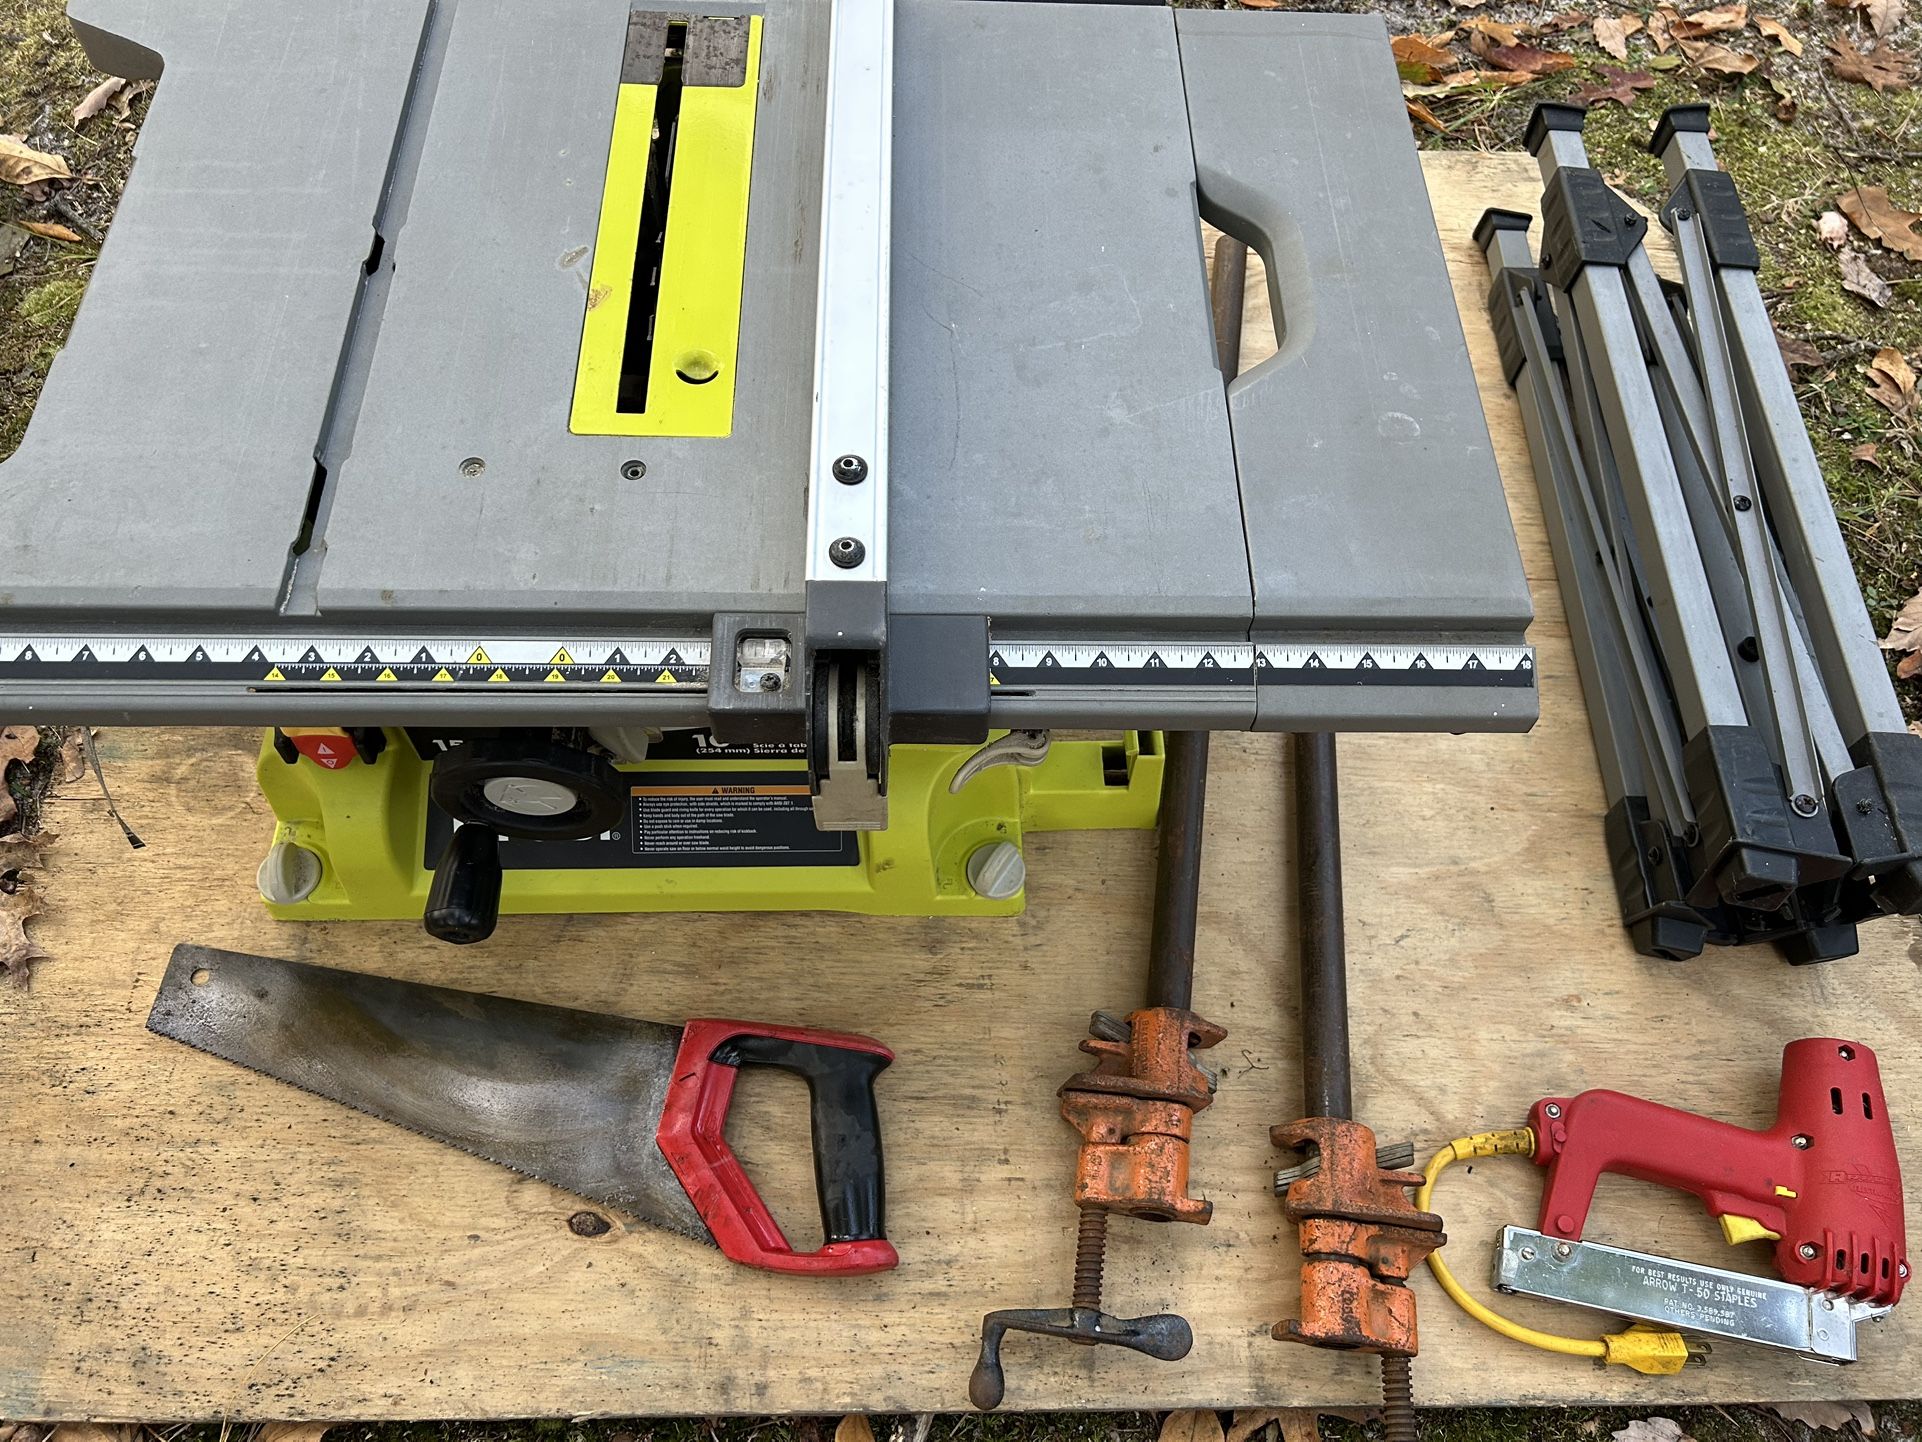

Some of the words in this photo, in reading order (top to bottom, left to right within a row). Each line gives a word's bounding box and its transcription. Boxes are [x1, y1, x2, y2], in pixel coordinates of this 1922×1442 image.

[24, 650, 32, 661] 8
[82, 651, 89, 660] 7
[138, 651, 146, 661] 6
[195, 651, 203, 661] 5
[252, 651, 260, 661] 4
[308, 652, 316, 662] 3
[364, 652, 372, 662] 2
[420, 652, 426, 662] 1
[476, 653, 482, 661] 0
[559, 654, 565, 662] 0
[614, 654, 621, 662] 1
[669, 654, 677, 663] 2
[992, 657, 1000, 666] 8
[1046, 657, 1052, 666] 9
[1096, 658, 1107, 667] 10
[1150, 658, 1160, 667] 11
[1203, 658, 1214, 667] 12
[1256, 658, 1267, 667] 13
[1309, 659, 1320, 668] 14
[1362, 659, 1373, 668] 15
[1415, 659, 1426, 668] 16
[1467, 660, 1478, 668] 17
[1521, 660, 1532, 669] 18
[1631, 1265, 1644, 1274] FOR
[1648, 1268, 1665, 1279] BEST
[1668, 1273, 1696, 1286] RESULTS
[1700, 1279, 1713, 1289] USE
[1717, 1283, 1734, 1293] ONLY
[1737, 1287, 1767, 1300] GENUINE
[1643, 1276, 1677, 1292] ARROW
[1714, 1291, 1758, 1308] STAPLES
[1664, 1298, 1679, 1307] PAT.
[1682, 1301, 1694, 1311] NO.
[1664, 1306, 1696, 1319] OTHERS
[1700, 1313, 1735, 1327] PENDING
